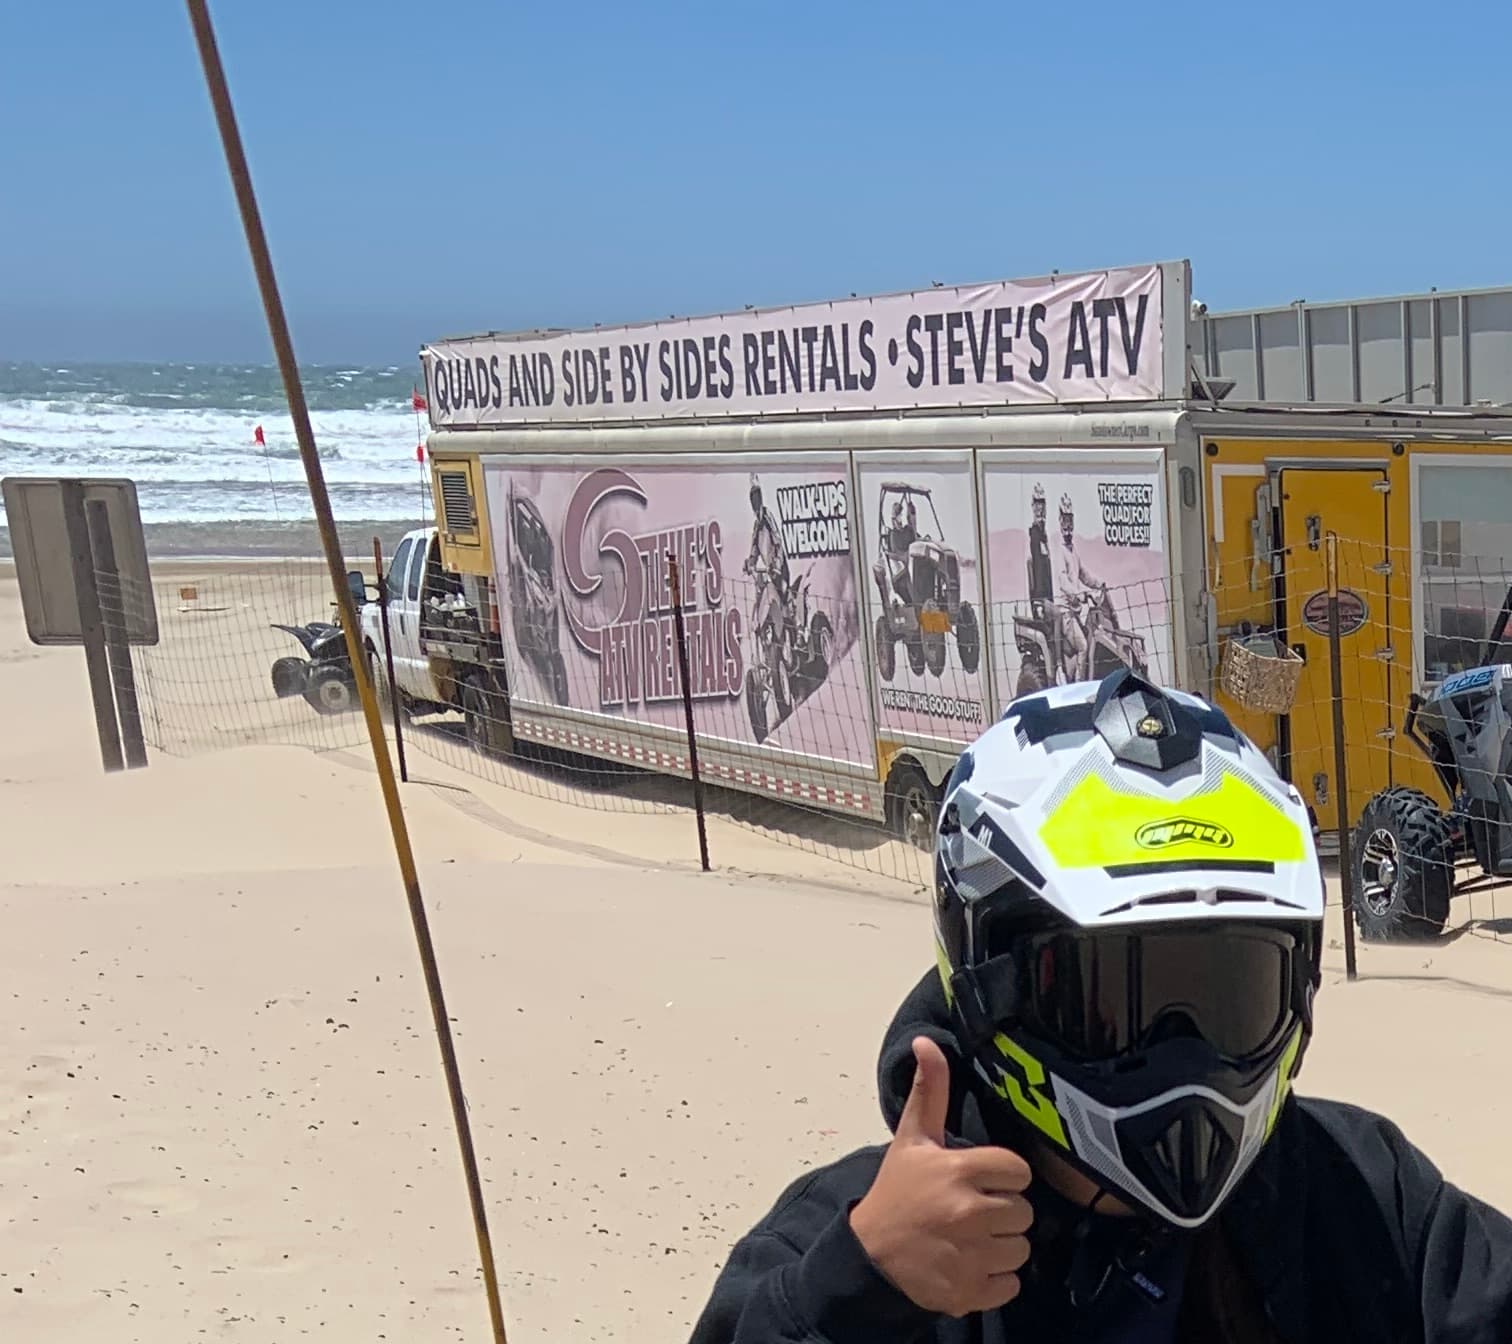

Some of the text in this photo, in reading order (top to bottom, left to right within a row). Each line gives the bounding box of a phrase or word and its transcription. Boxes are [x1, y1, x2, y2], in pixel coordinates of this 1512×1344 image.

[434, 294, 1148, 415] QUADS AND SIDE BY SIDES RENTALS STEVE'S ATV
[777, 481, 847, 521] WALK-UPS
[1098, 483, 1152, 505] THE PERFECT
[1103, 504, 1150, 525] QUAD FOR
[782, 519, 850, 558] WELCOME
[600, 619, 642, 704] ATV
[929, 694, 954, 719] GOOD
